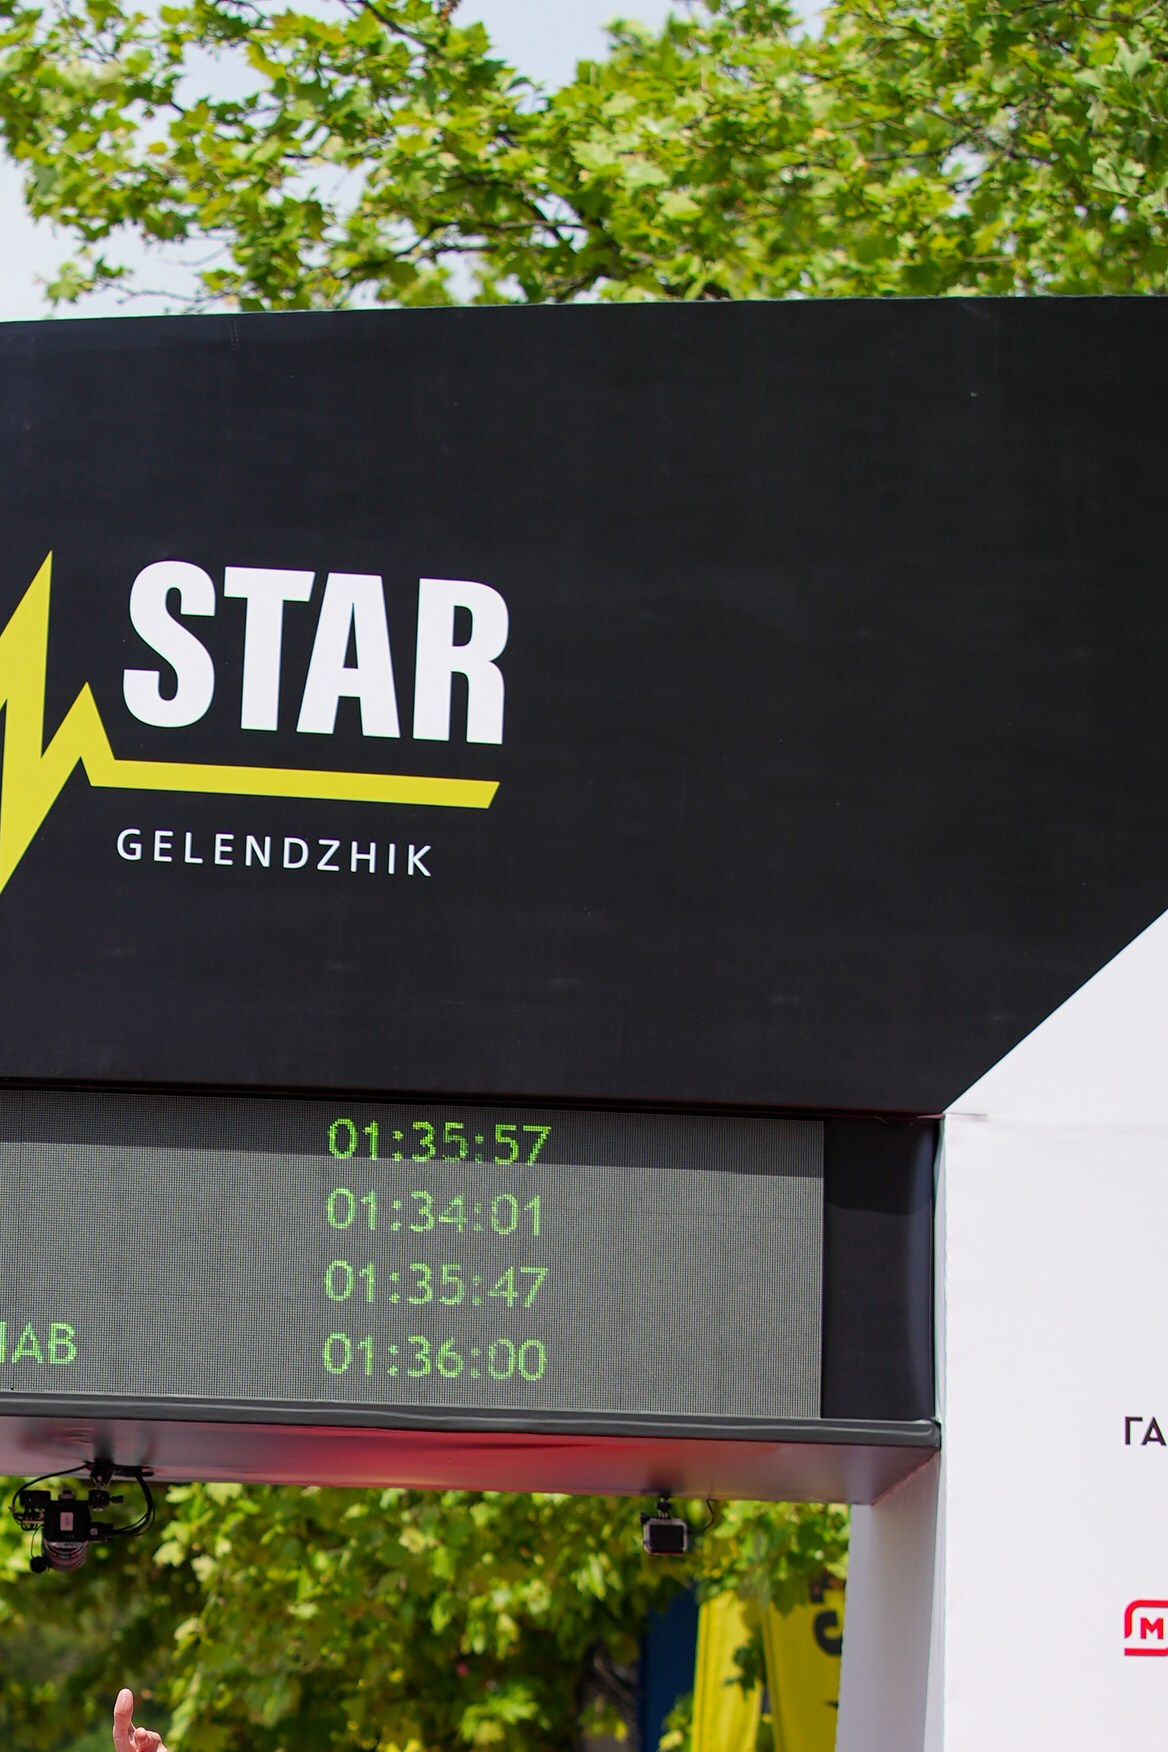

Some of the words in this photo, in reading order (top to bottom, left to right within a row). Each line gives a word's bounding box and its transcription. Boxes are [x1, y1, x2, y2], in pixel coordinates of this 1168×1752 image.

[123, 560, 509, 745] STAR
[116, 828, 433, 877] GELENDZHIK
[327, 1118, 551, 1166] 01:35:57
[325, 1187, 542, 1237] 01:34:01
[323, 1260, 549, 1308] 01:35:47
[322, 1332, 548, 1382] 01:36:00
